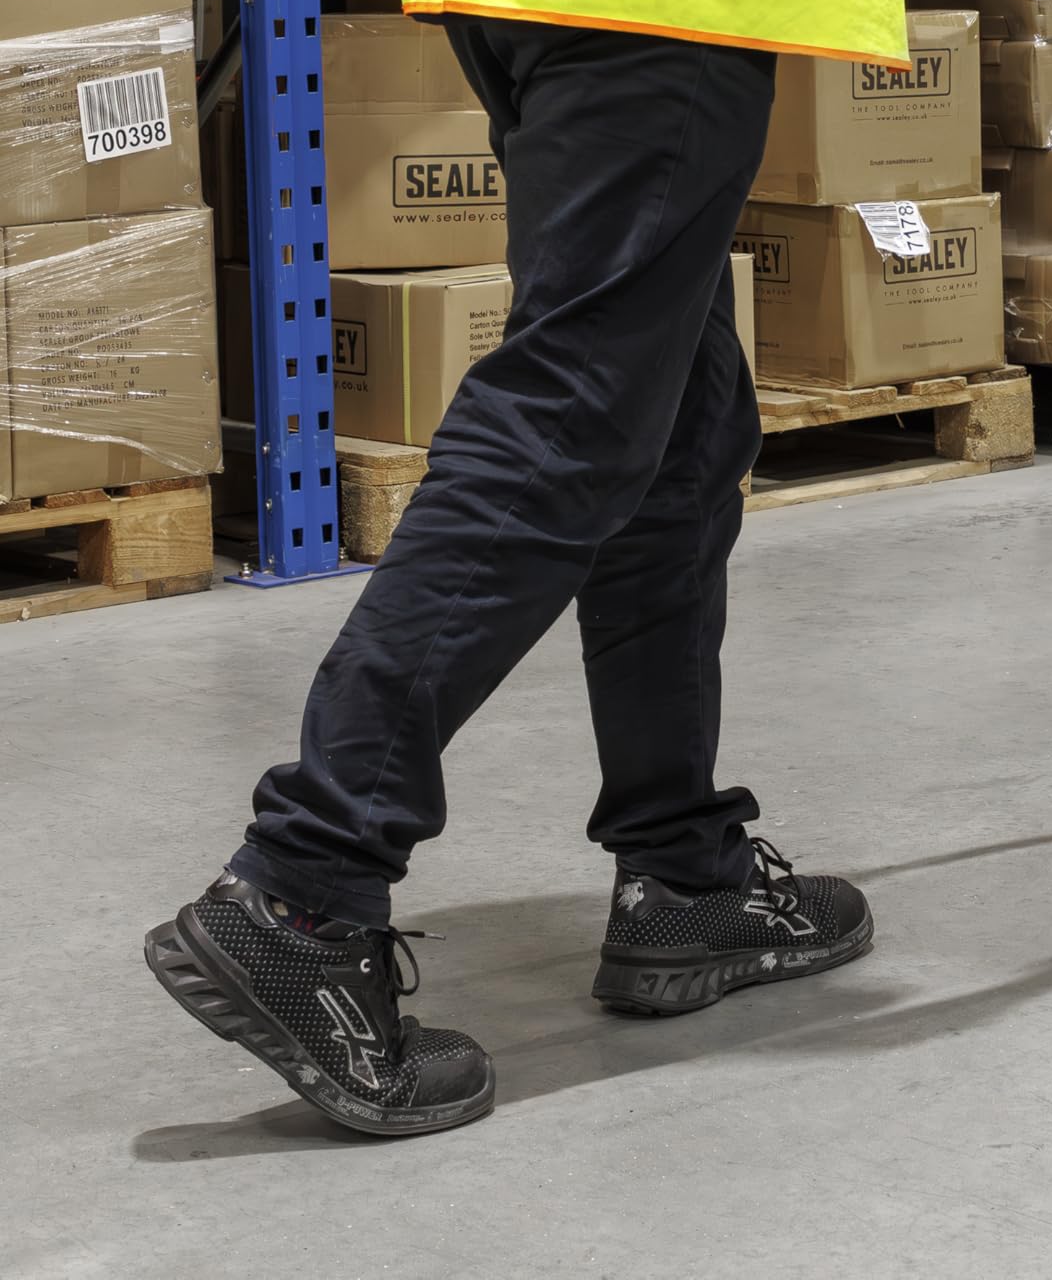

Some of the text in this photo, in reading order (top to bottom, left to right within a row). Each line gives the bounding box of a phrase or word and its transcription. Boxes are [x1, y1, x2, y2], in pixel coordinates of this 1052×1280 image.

[862, 57, 942, 91] SEALEY
[875, 104, 899, 112] TOOL
[906, 102, 952, 111] COMPANY
[88, 121, 167, 156] 700398
[406, 162, 499, 198] SEALE
[393, 210, 508, 224] www.sealey.co
[897, 200, 924, 252] 7178
[892, 236, 968, 276] SEALEY
[906, 287, 931, 296] TOOL
[936, 282, 979, 293] COMPANY
[470, 310, 487, 319] Model
[470, 322, 490, 330] Carton
[470, 333, 483, 341] Sole
[41, 376, 66, 386] GROSS
[124, 380, 135, 389] CM
